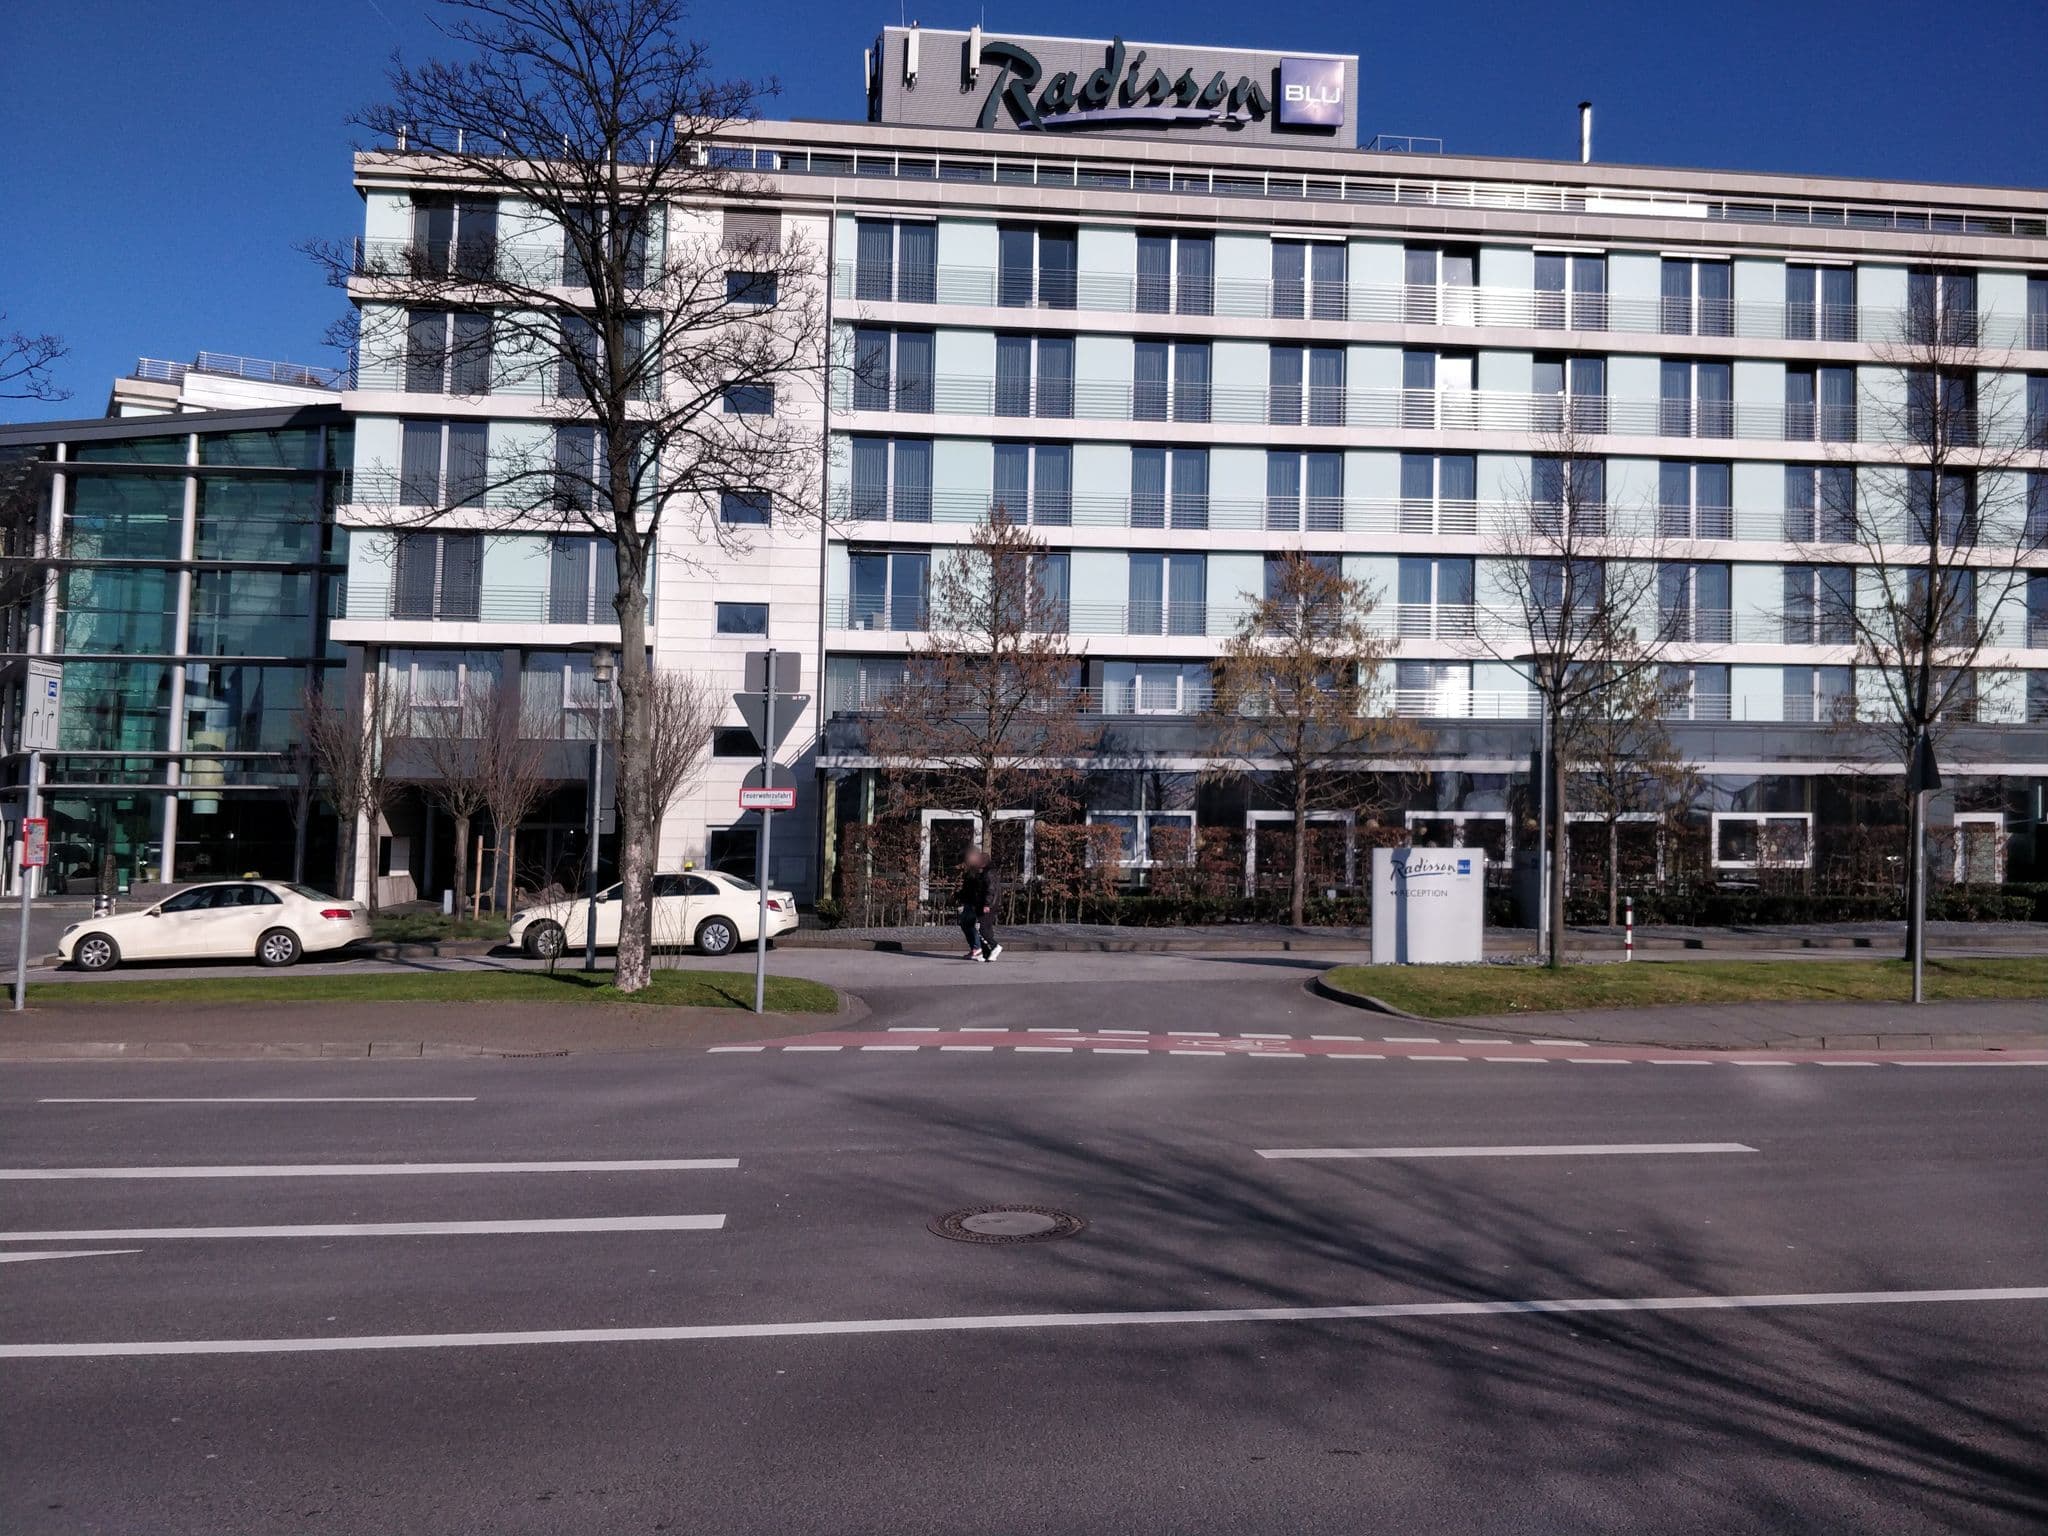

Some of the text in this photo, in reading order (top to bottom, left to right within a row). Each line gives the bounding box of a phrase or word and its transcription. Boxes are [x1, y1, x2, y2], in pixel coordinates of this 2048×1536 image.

[977, 35, 1340, 131] Radisson BLU
[1390, 857, 1456, 881] Radisson
